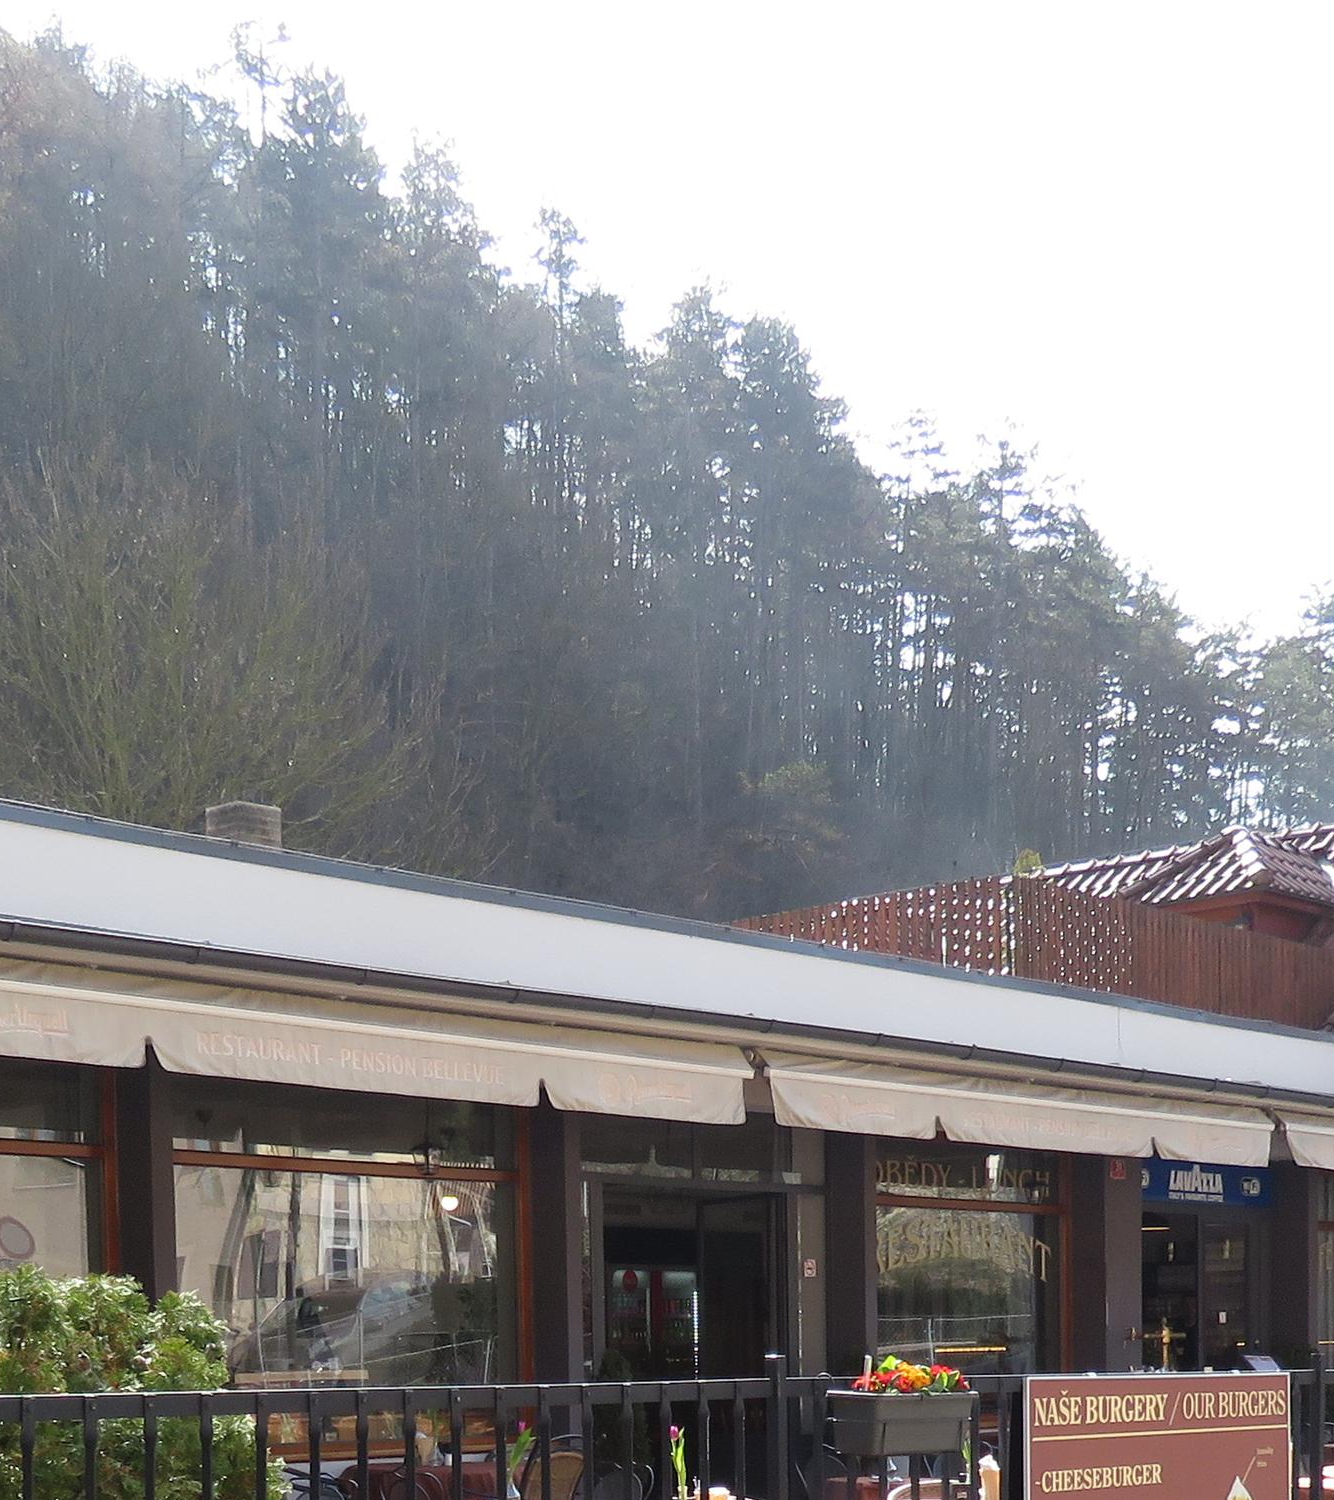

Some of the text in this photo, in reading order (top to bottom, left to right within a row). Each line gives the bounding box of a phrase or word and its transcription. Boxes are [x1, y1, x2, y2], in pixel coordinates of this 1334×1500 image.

[195, 1031, 322, 1065] RESTAURANT
[340, 1048, 416, 1078] PENSION
[423, 1056, 504, 1086] BELLEVUE
[1168, 1165, 1224, 1194] LAVAZZA
[1034, 1389, 1287, 1426] NAŠE BURGERY / OUR BURGERS
